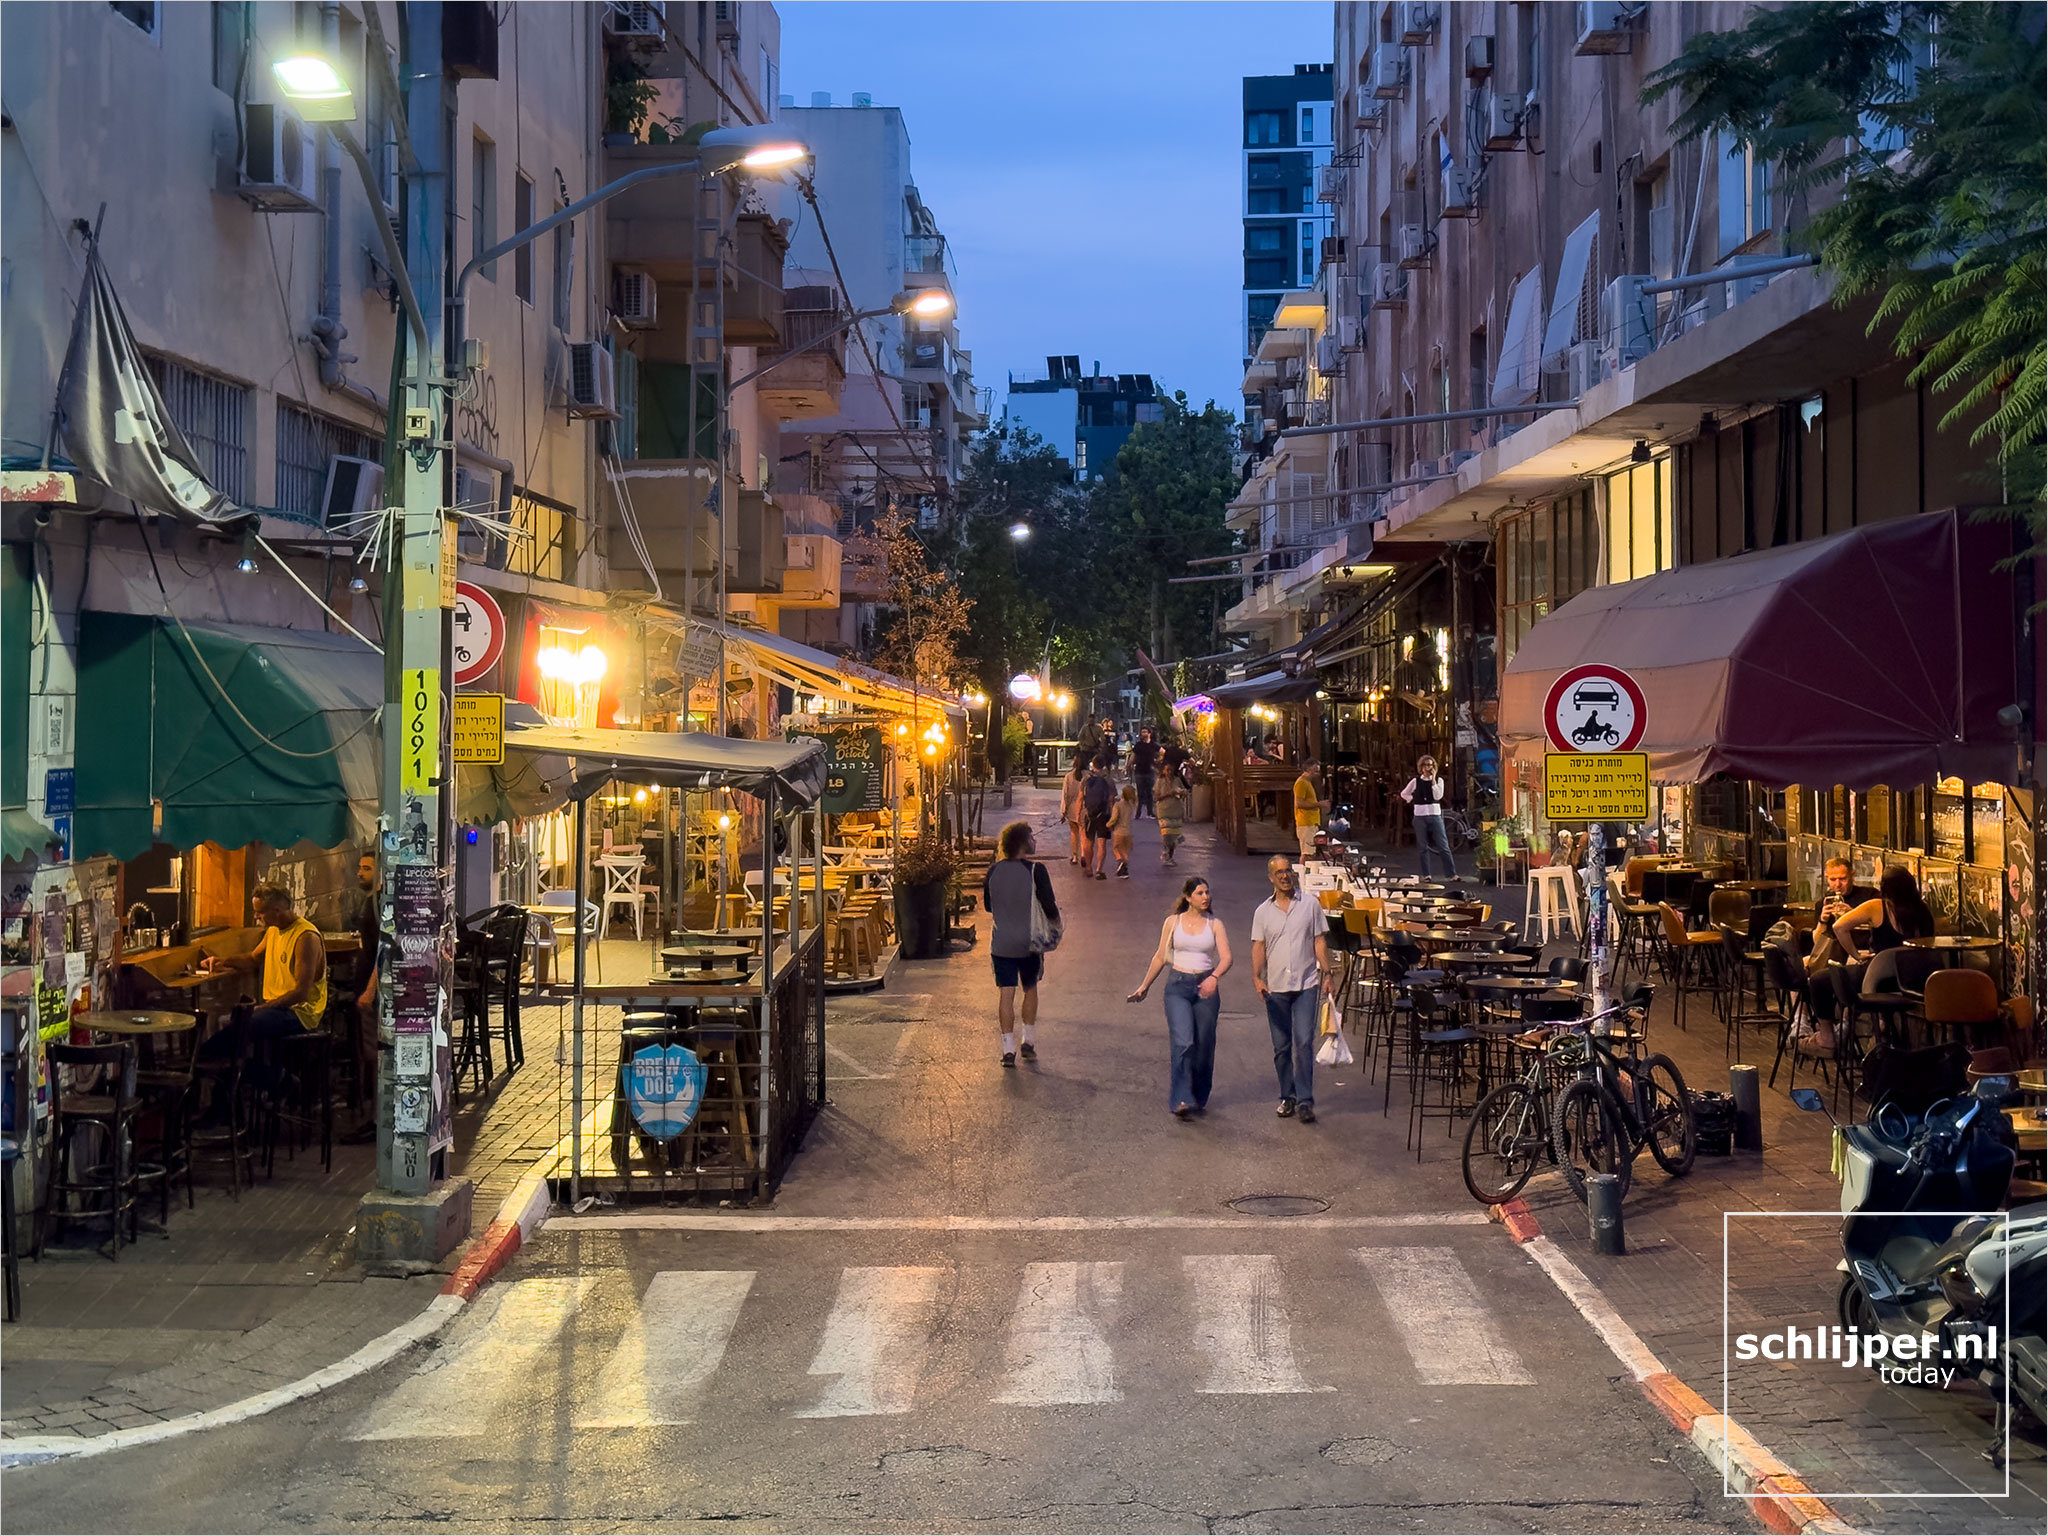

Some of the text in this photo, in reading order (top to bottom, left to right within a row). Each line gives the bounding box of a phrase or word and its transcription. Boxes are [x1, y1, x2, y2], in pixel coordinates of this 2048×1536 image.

[455, 702, 476, 710] מותר
[411, 670, 427, 778] 10691
[456, 716, 496, 725] לדיירי רח
[454, 732, 464, 740] רח
[835, 736, 870, 750] Beer
[454, 748, 496, 756] בתים מספ
[1570, 759, 1622, 768] מותרת כניסה
[1551, 772, 1642, 784] לדיירי רחוב קורדובידו
[1549, 788, 1644, 798] ולדיירי רחוב ויטל חיים
[1550, 804, 1572, 814] בלבד
[1598, 805, 1620, 814] מספר
[1624, 805, 1644, 813] בתים
[635, 1056, 680, 1078] BREW
[644, 1076, 674, 1096] DOG
